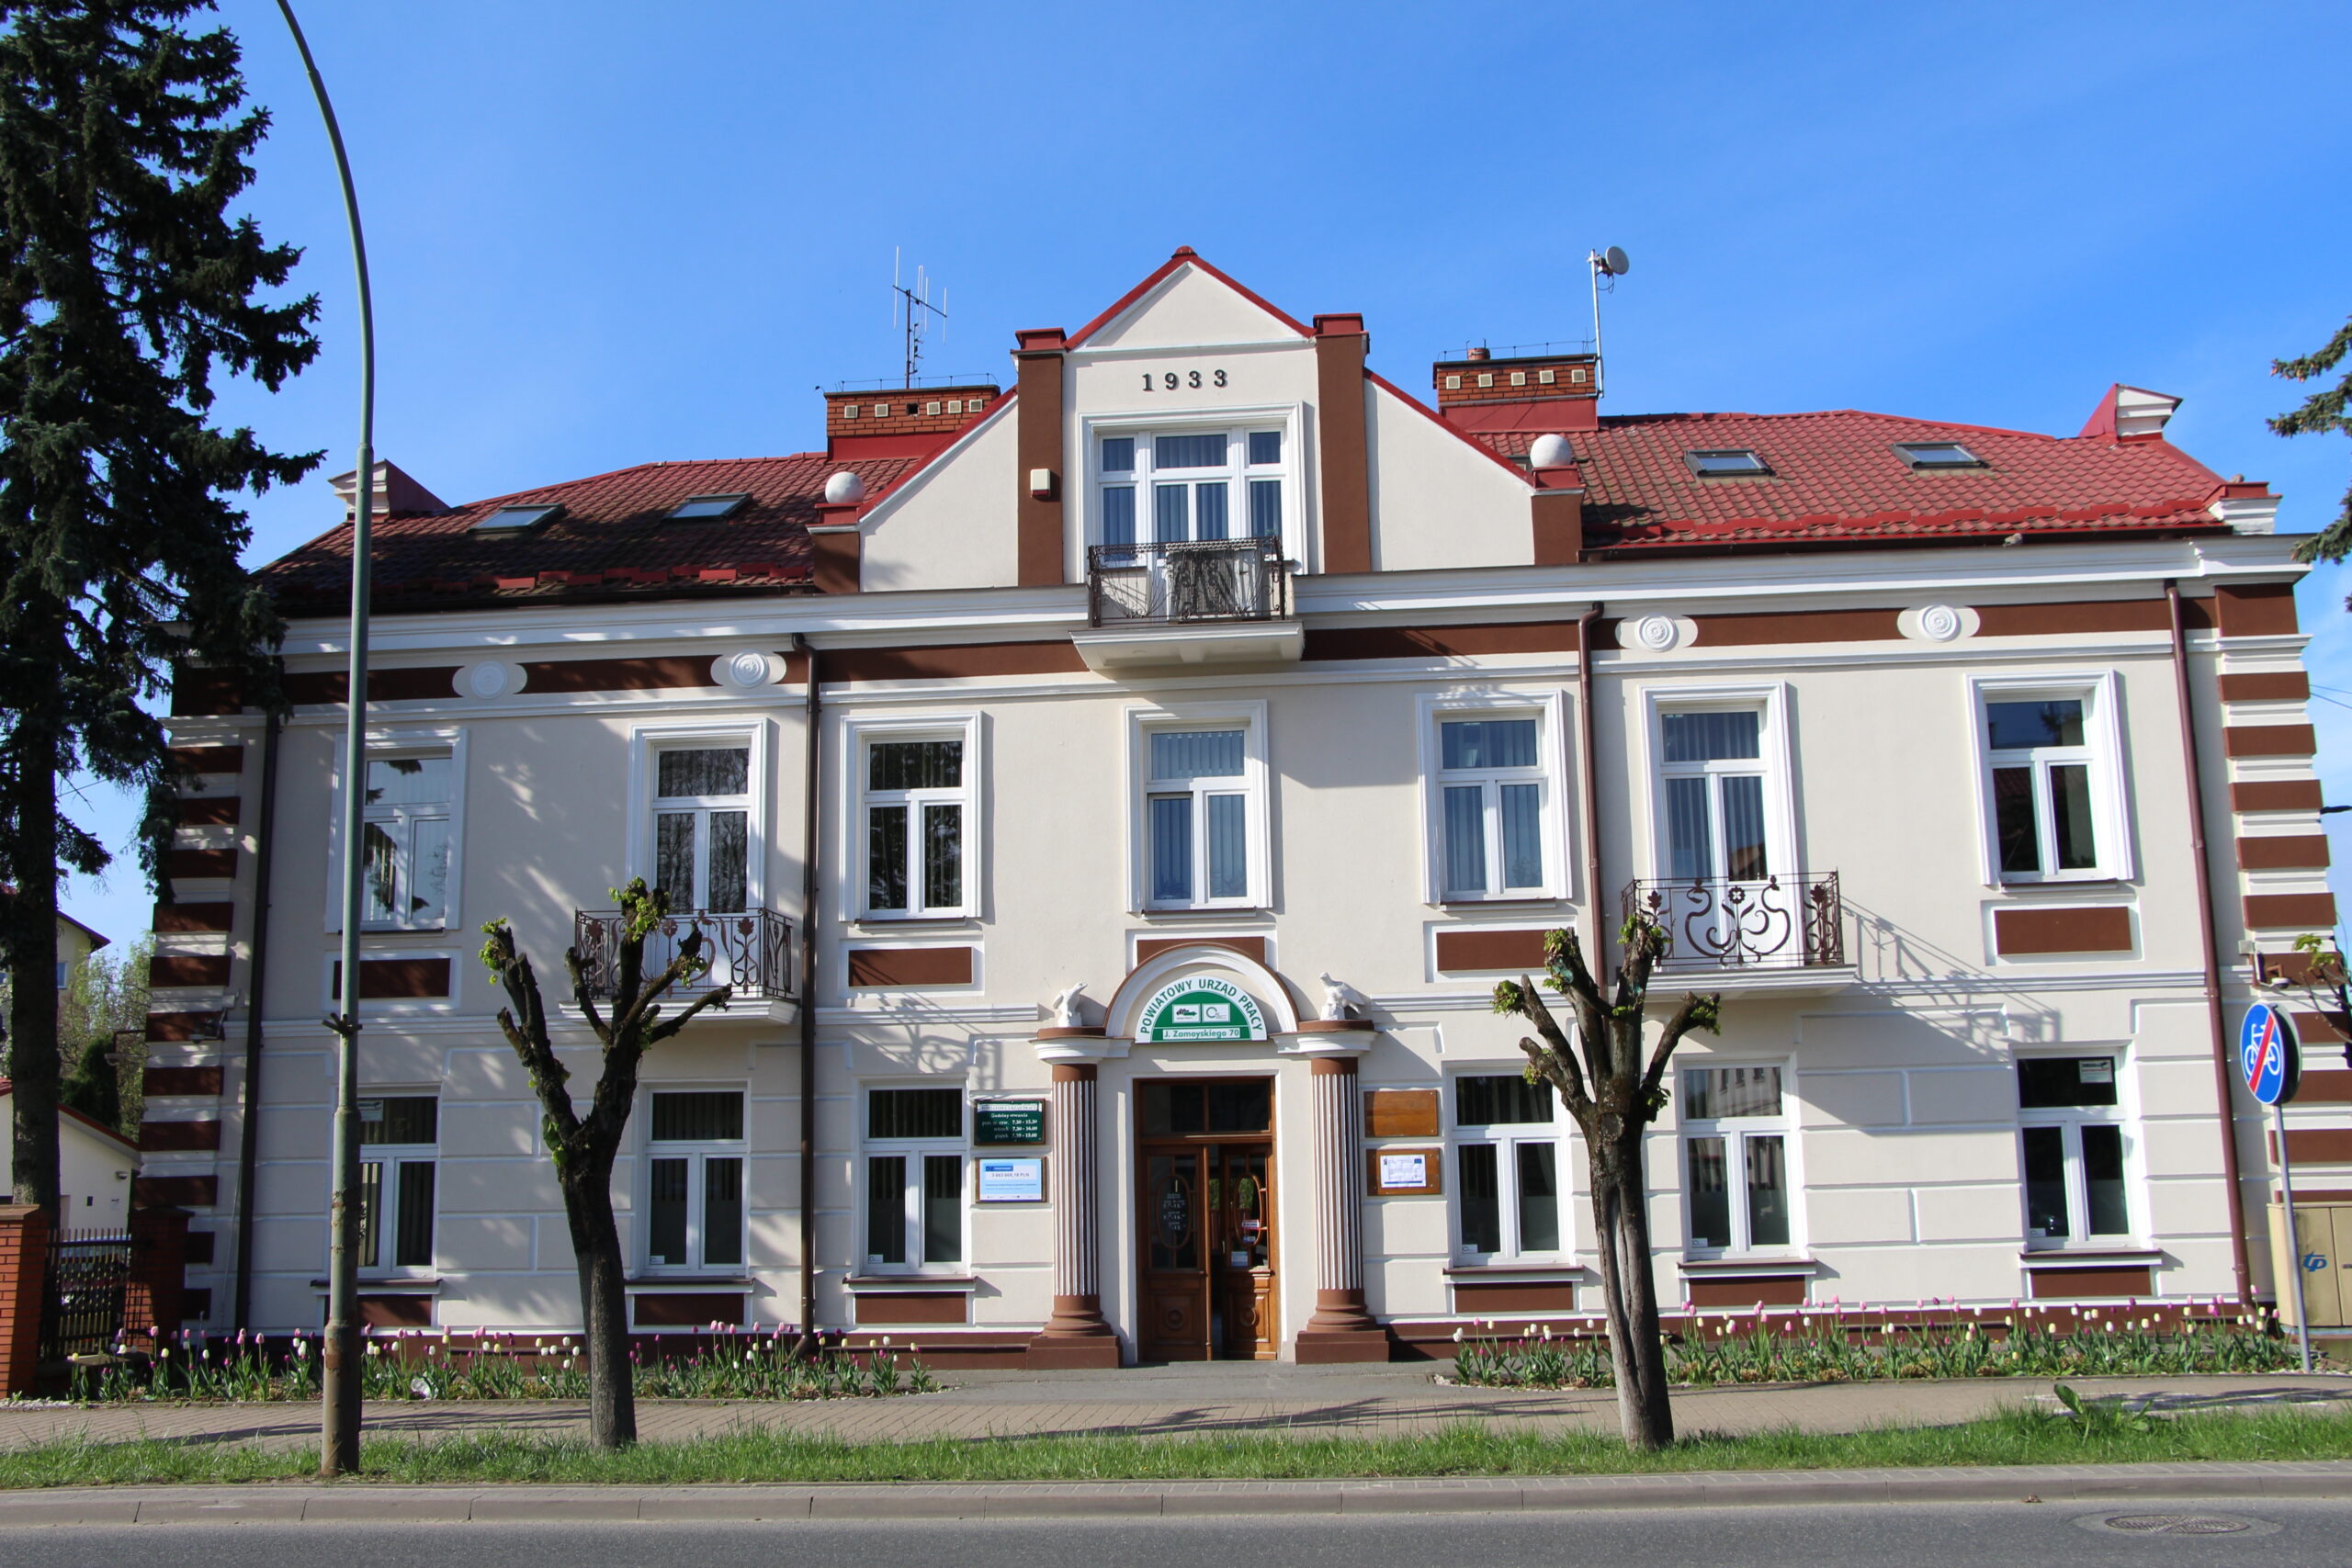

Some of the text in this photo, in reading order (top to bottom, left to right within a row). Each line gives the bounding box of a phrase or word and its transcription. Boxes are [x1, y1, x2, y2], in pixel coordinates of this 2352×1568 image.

[1142, 369, 1228, 391] 1933
[1140, 979, 1193, 1034] POWIATOWY
[1238, 995, 1262, 1032] PRACY
[1173, 1029, 1227, 1039] Zamoyskiego
